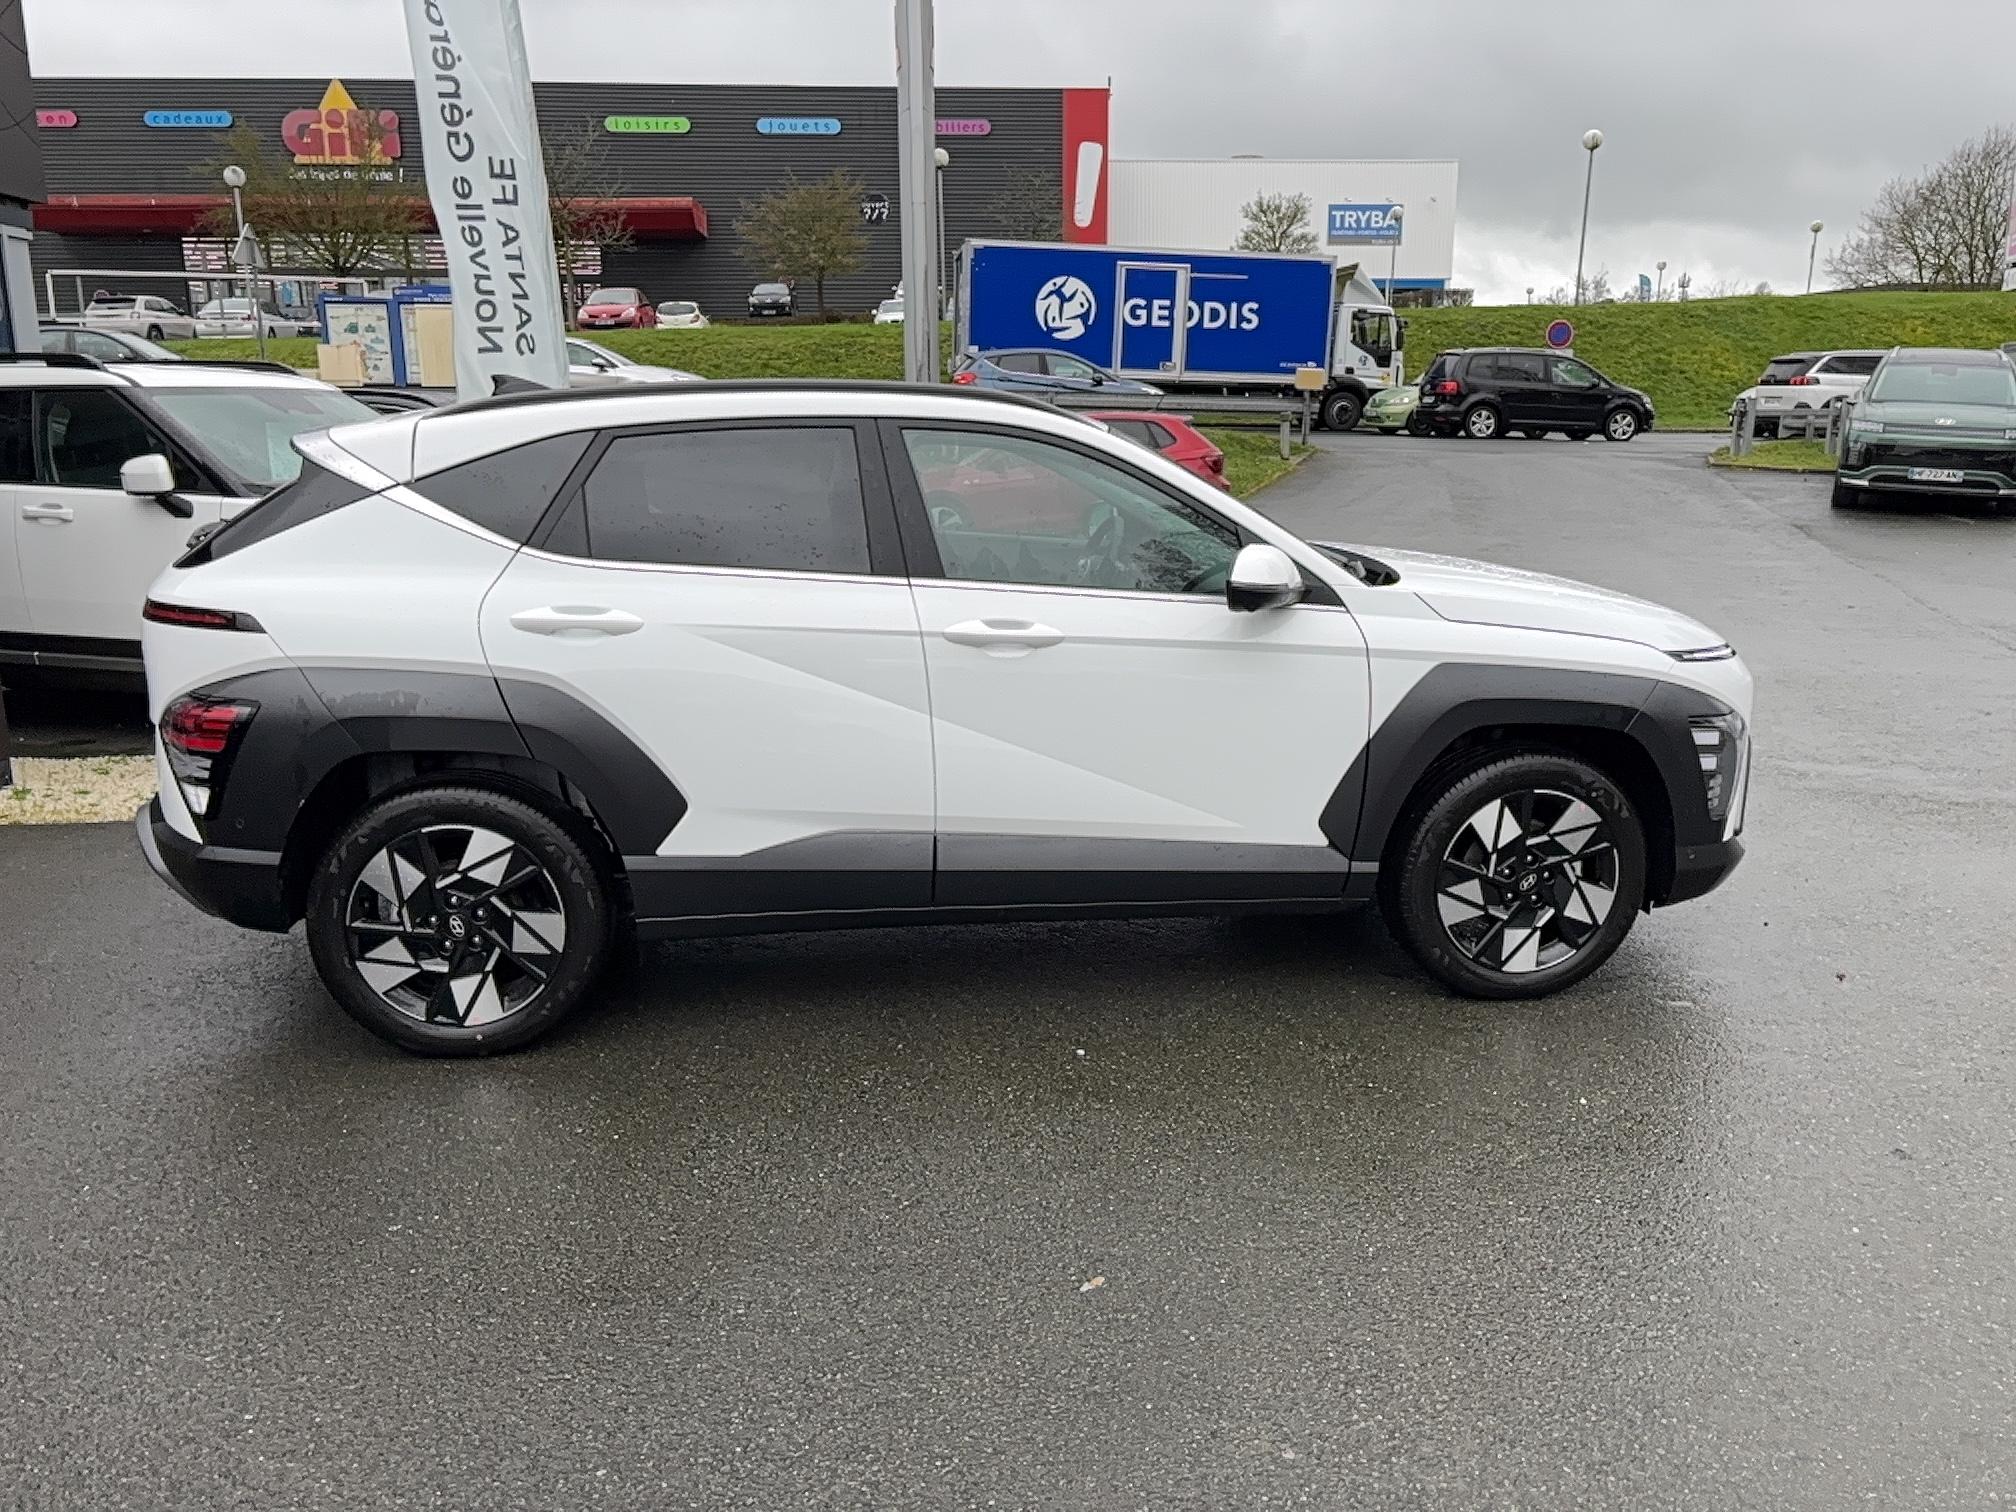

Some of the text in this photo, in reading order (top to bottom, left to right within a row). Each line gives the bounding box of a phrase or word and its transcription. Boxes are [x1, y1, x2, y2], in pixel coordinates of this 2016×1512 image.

[37, 115, 67, 124] on
[153, 114, 223, 124] cadeaux
[614, 118, 681, 130] loisirs
[768, 119, 830, 132] jouets
[1332, 210, 1399, 228] TRYBA
[1123, 298, 1260, 331] GEODIS
